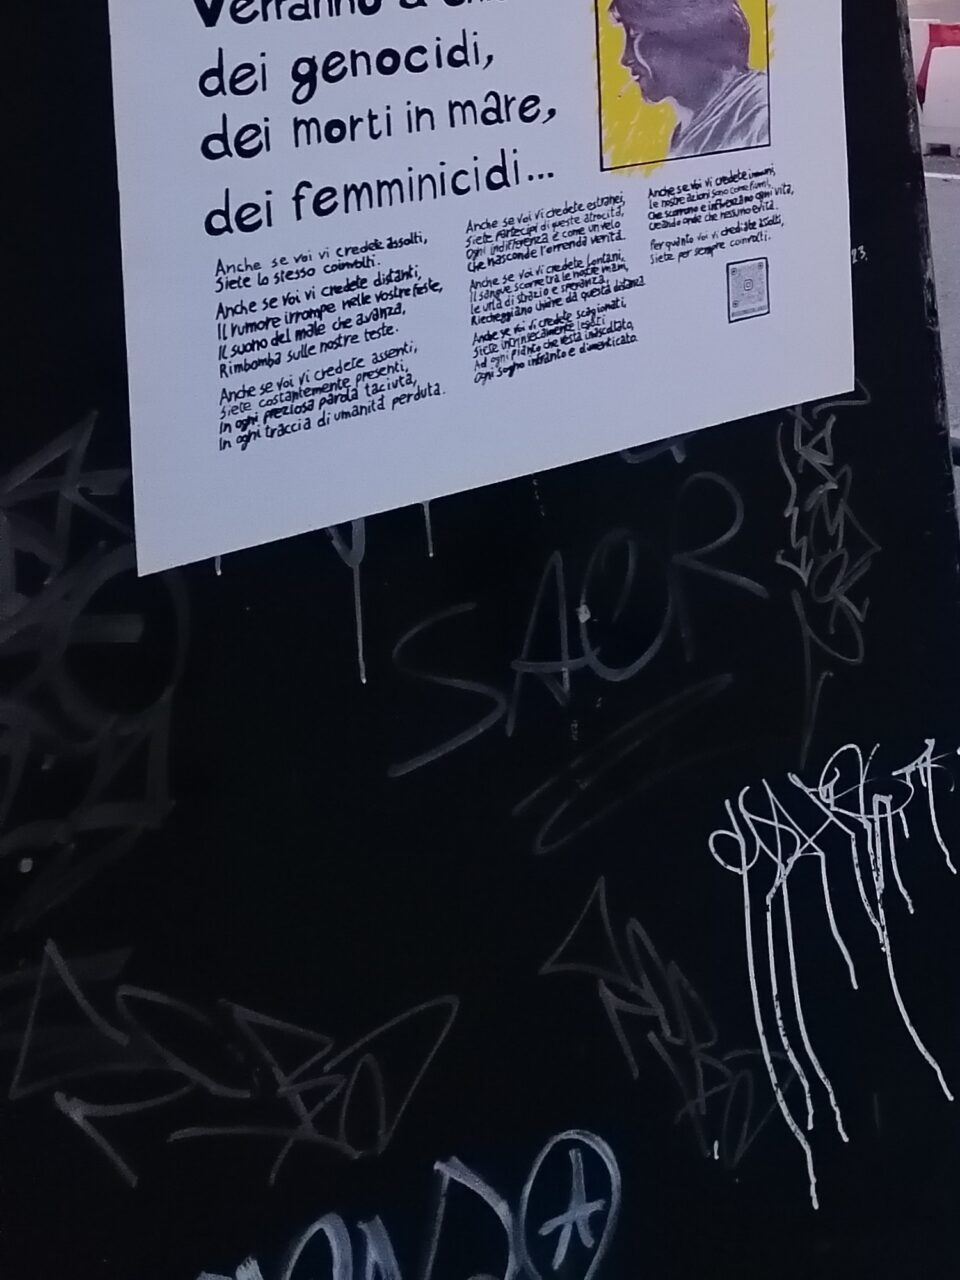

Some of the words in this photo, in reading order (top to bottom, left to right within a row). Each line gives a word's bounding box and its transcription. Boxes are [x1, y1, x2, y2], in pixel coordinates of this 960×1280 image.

[199, 47, 267, 98] dei
[291, 28, 495, 105] genocidi,
[200, 112, 271, 161] dei
[293, 104, 392, 148] morti
[406, 100, 435, 134] in
[448, 90, 557, 129] mare,
[203, 187, 272, 237] dei
[291, 148, 554, 221] femminicidi...
[648, 186, 675, 198] Anche
[677, 184, 690, 194] se
[690, 179, 702, 190] voi
[705, 177, 712, 187] vi
[715, 169, 747, 186] credete
[662, 196, 686, 207] nostre
[687, 190, 710, 202] azioni
[731, 185, 749, 194] come
[466, 218, 498, 234] Anche
[502, 217, 515, 228] se
[517, 211, 532, 224] voi
[535, 208, 544, 220] vi
[546, 200, 585, 218] credete
[586, 190, 626, 211] estranei,
[541, 220, 549, 231] di
[552, 215, 581, 232] queste
[665, 206, 698, 218] scorrono
[700, 204, 706, 212] e
[682, 215, 702, 225] onde
[704, 212, 718, 223] che
[720, 206, 751, 219] nessuno
[215, 258, 262, 277] Anche
[271, 256, 289, 268] se
[294, 249, 312, 264] voi
[318, 246, 330, 260] vi
[335, 238, 384, 258] credete
[386, 231, 428, 250] assolti,
[487, 247, 538, 267] nasconde
[540, 234, 587, 256] l'orrenda
[490, 233, 549, 256] indifferenza
[562, 227, 585, 238] come
[588, 224, 600, 233] un
[600, 220, 621, 231] velo
[665, 233, 694, 251] quanto
[678, 249, 692, 262] per
[694, 241, 725, 257] sempre
[215, 275, 251, 293] Siete
[257, 272, 270, 286] lo
[273, 266, 316, 285] stesso
[323, 254, 381, 274] coinvolti.
[215, 300, 257, 320] Anche
[263, 295, 278, 310] se
[282, 288, 301, 306] voi
[305, 286, 316, 300] vi
[321, 276, 368, 298] credete
[373, 265, 422, 287] distanti,
[469, 276, 500, 291] Anche
[502, 273, 515, 285] se
[519, 267, 534, 280] voi
[536, 264, 545, 276] vi
[546, 256, 585, 275] credete
[479, 284, 513, 301] sangue
[514, 278, 544, 292] scorre
[546, 276, 560, 286] tra
[562, 272, 572, 282] le
[573, 265, 599, 279] nostre
[217, 323, 228, 340] Il
[231, 313, 281, 336] rumore
[285, 300, 336, 322] irrompe
[342, 291, 371, 310] nelle
[375, 285, 411, 303] vostre
[471, 306, 533, 326] Riecheggiano
[566, 290, 578, 303] da
[581, 284, 611, 301] questa
[483, 299, 502, 311] urla
[505, 295, 514, 306] di
[517, 287, 549, 304] strazio
[551, 286, 558, 295] e
[218, 345, 227, 360] Il
[231, 338, 268, 358] suono
[270, 329, 292, 348] del
[295, 321, 326, 342] male
[332, 316, 353, 332] che
[355, 302, 406, 325] avanza,
[472, 329, 499, 345] Anche
[500, 328, 511, 338] se
[539, 309, 572, 328] credete
[219, 351, 282, 379] Rimbomba
[286, 343, 317, 363] sulle
[319, 332, 360, 353] nostre
[364, 322, 399, 343] teste.
[474, 357, 487, 371] Ad
[490, 351, 509, 367] ogni
[511, 343, 541, 360] pianto
[543, 339, 559, 349] che
[560, 332, 582, 345] resta
[497, 362, 525, 377] sogno
[528, 349, 567, 366] infranto
[568, 347, 576, 356] e
[219, 384, 257, 406] Anche
[259, 381, 274, 397] se
[276, 375, 294, 392] voi
[299, 370, 310, 386] vi
[314, 355, 366, 381] credete
[371, 340, 418, 364] assenti,
[258, 376, 351, 409] costantemente
[355, 360, 409, 387] presenti,
[219, 421, 232, 435] In
[235, 412, 259, 432] ogni
[263, 398, 314, 424] preziosa
[318, 387, 359, 410] parola
[365, 373, 418, 398] taciuta,
[219, 437, 232, 451] In
[236, 425, 261, 451] ogni
[265, 414, 312, 439] traccia
[317, 411, 330, 428] di
[391, 382, 446, 411] perduta.
